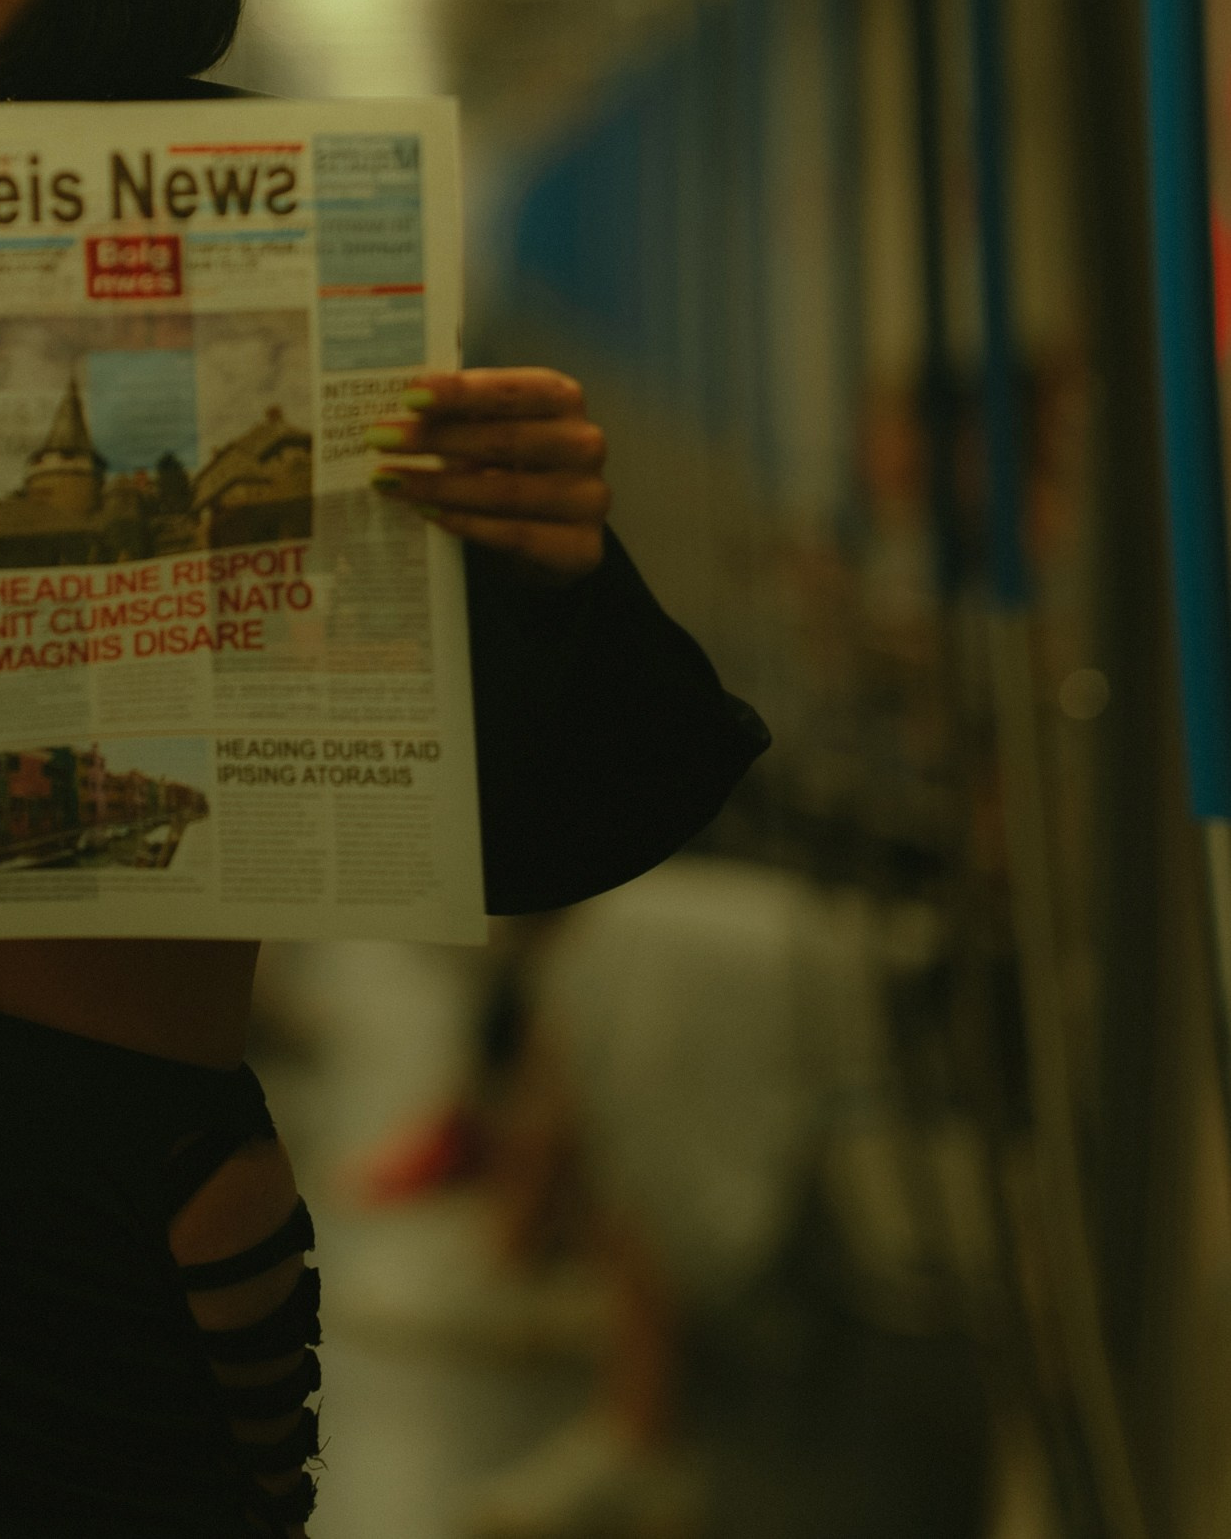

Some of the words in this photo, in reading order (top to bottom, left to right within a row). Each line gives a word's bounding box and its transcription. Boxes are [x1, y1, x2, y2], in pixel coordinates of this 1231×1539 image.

[48, 589, 207, 636] CUMSCIS
[218, 579, 313, 616] NATO
[132, 618, 264, 658] DISARE
[216, 738, 317, 761] HEADING
